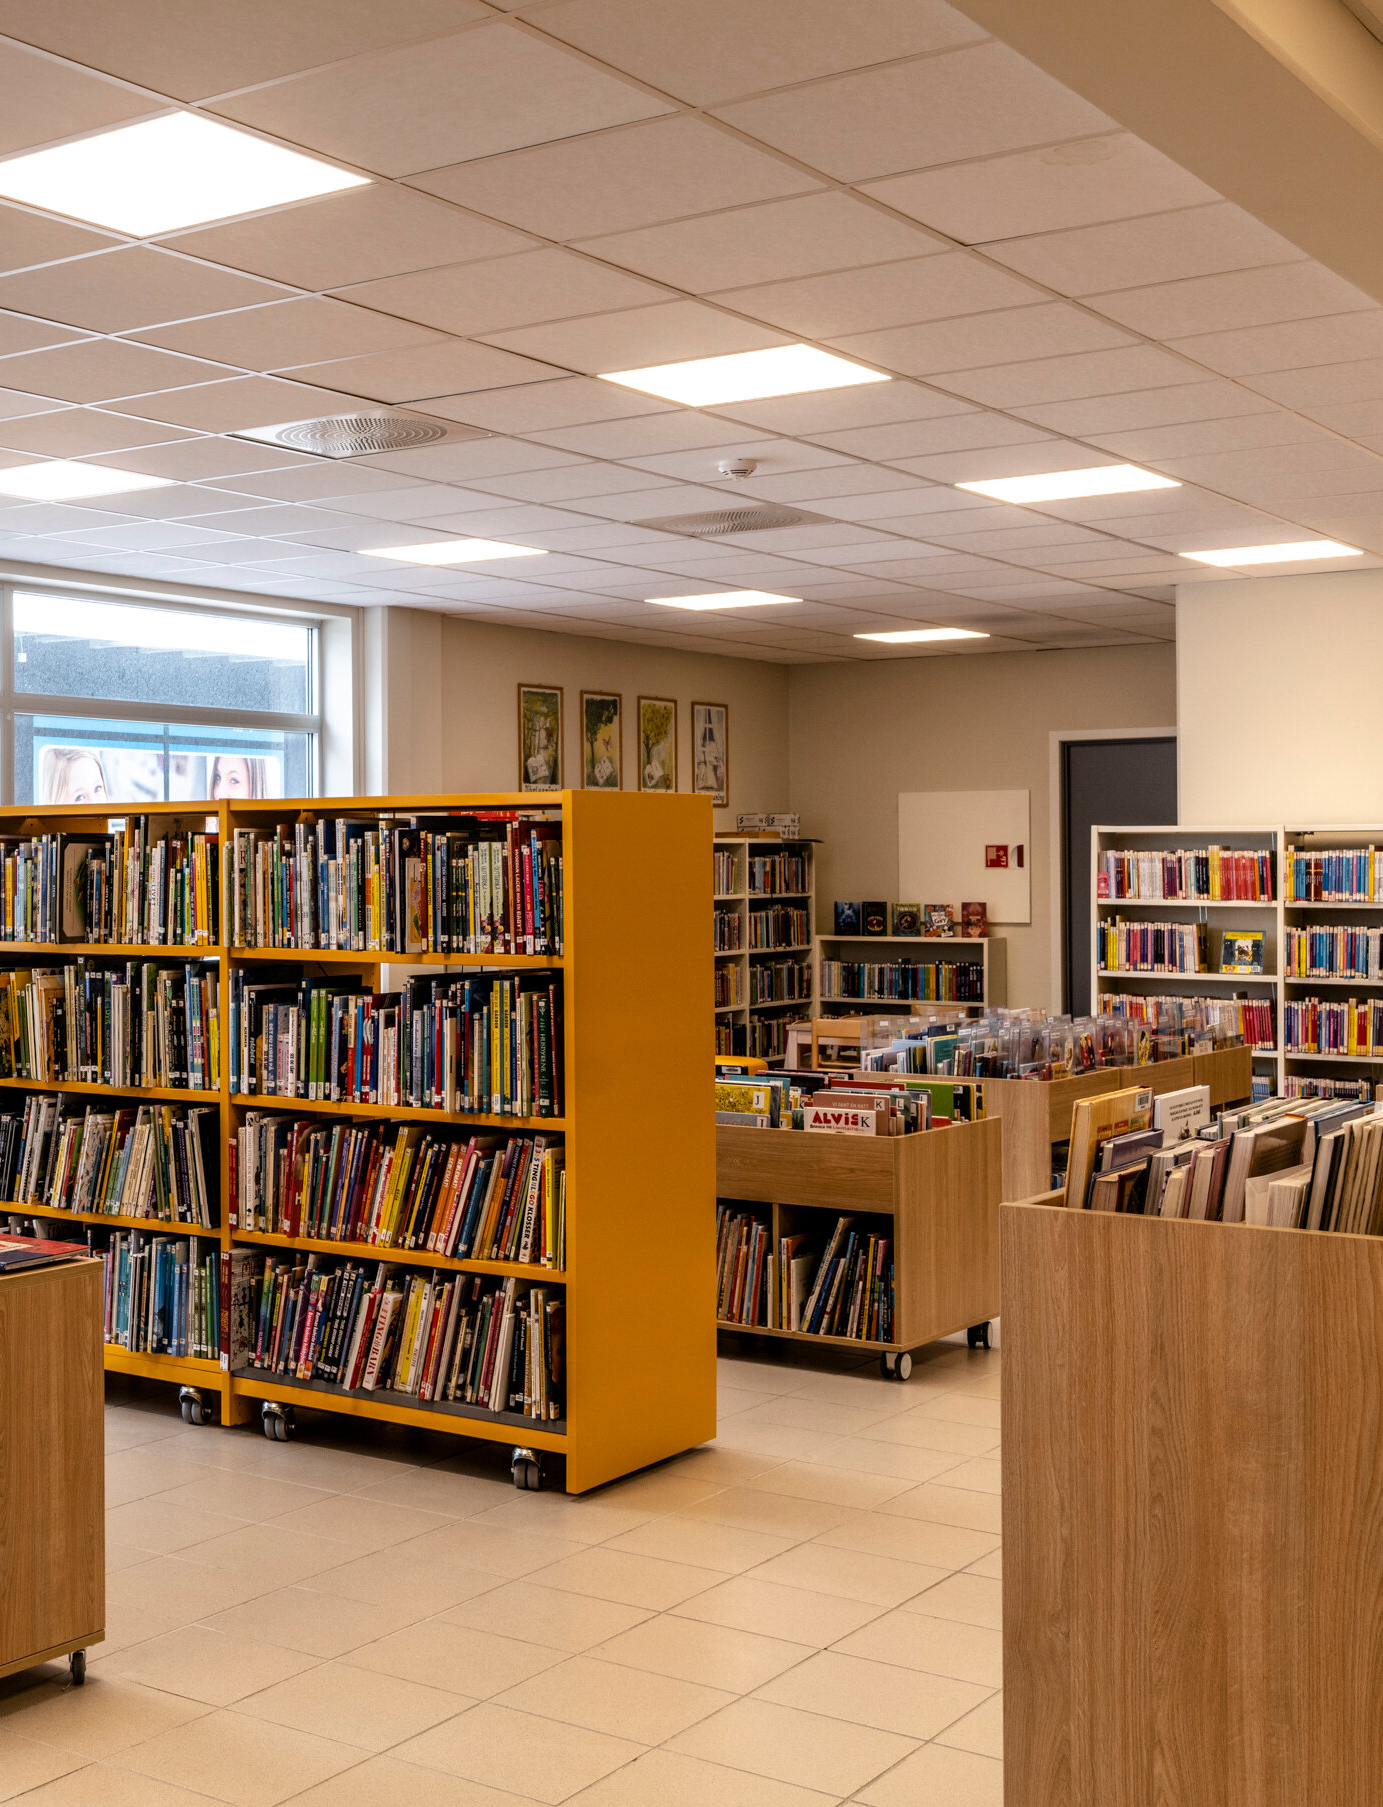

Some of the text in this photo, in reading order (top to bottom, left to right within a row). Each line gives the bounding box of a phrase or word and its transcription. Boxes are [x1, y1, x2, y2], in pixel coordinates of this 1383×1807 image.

[539, 1034, 547, 1073] HUSDYRENE
[875, 1099, 882, 1109] K
[896, 1099, 903, 1109] L
[860, 1117, 871, 1128] K
[531, 1163, 539, 1181] TING
[528, 1186, 536, 1205] LEGO
[523, 1206, 534, 1239] KLOSSER
[302, 1326, 310, 1343] kuleste
[307, 1343, 315, 1361] kokebok
[366, 1347, 380, 1376] BARN
